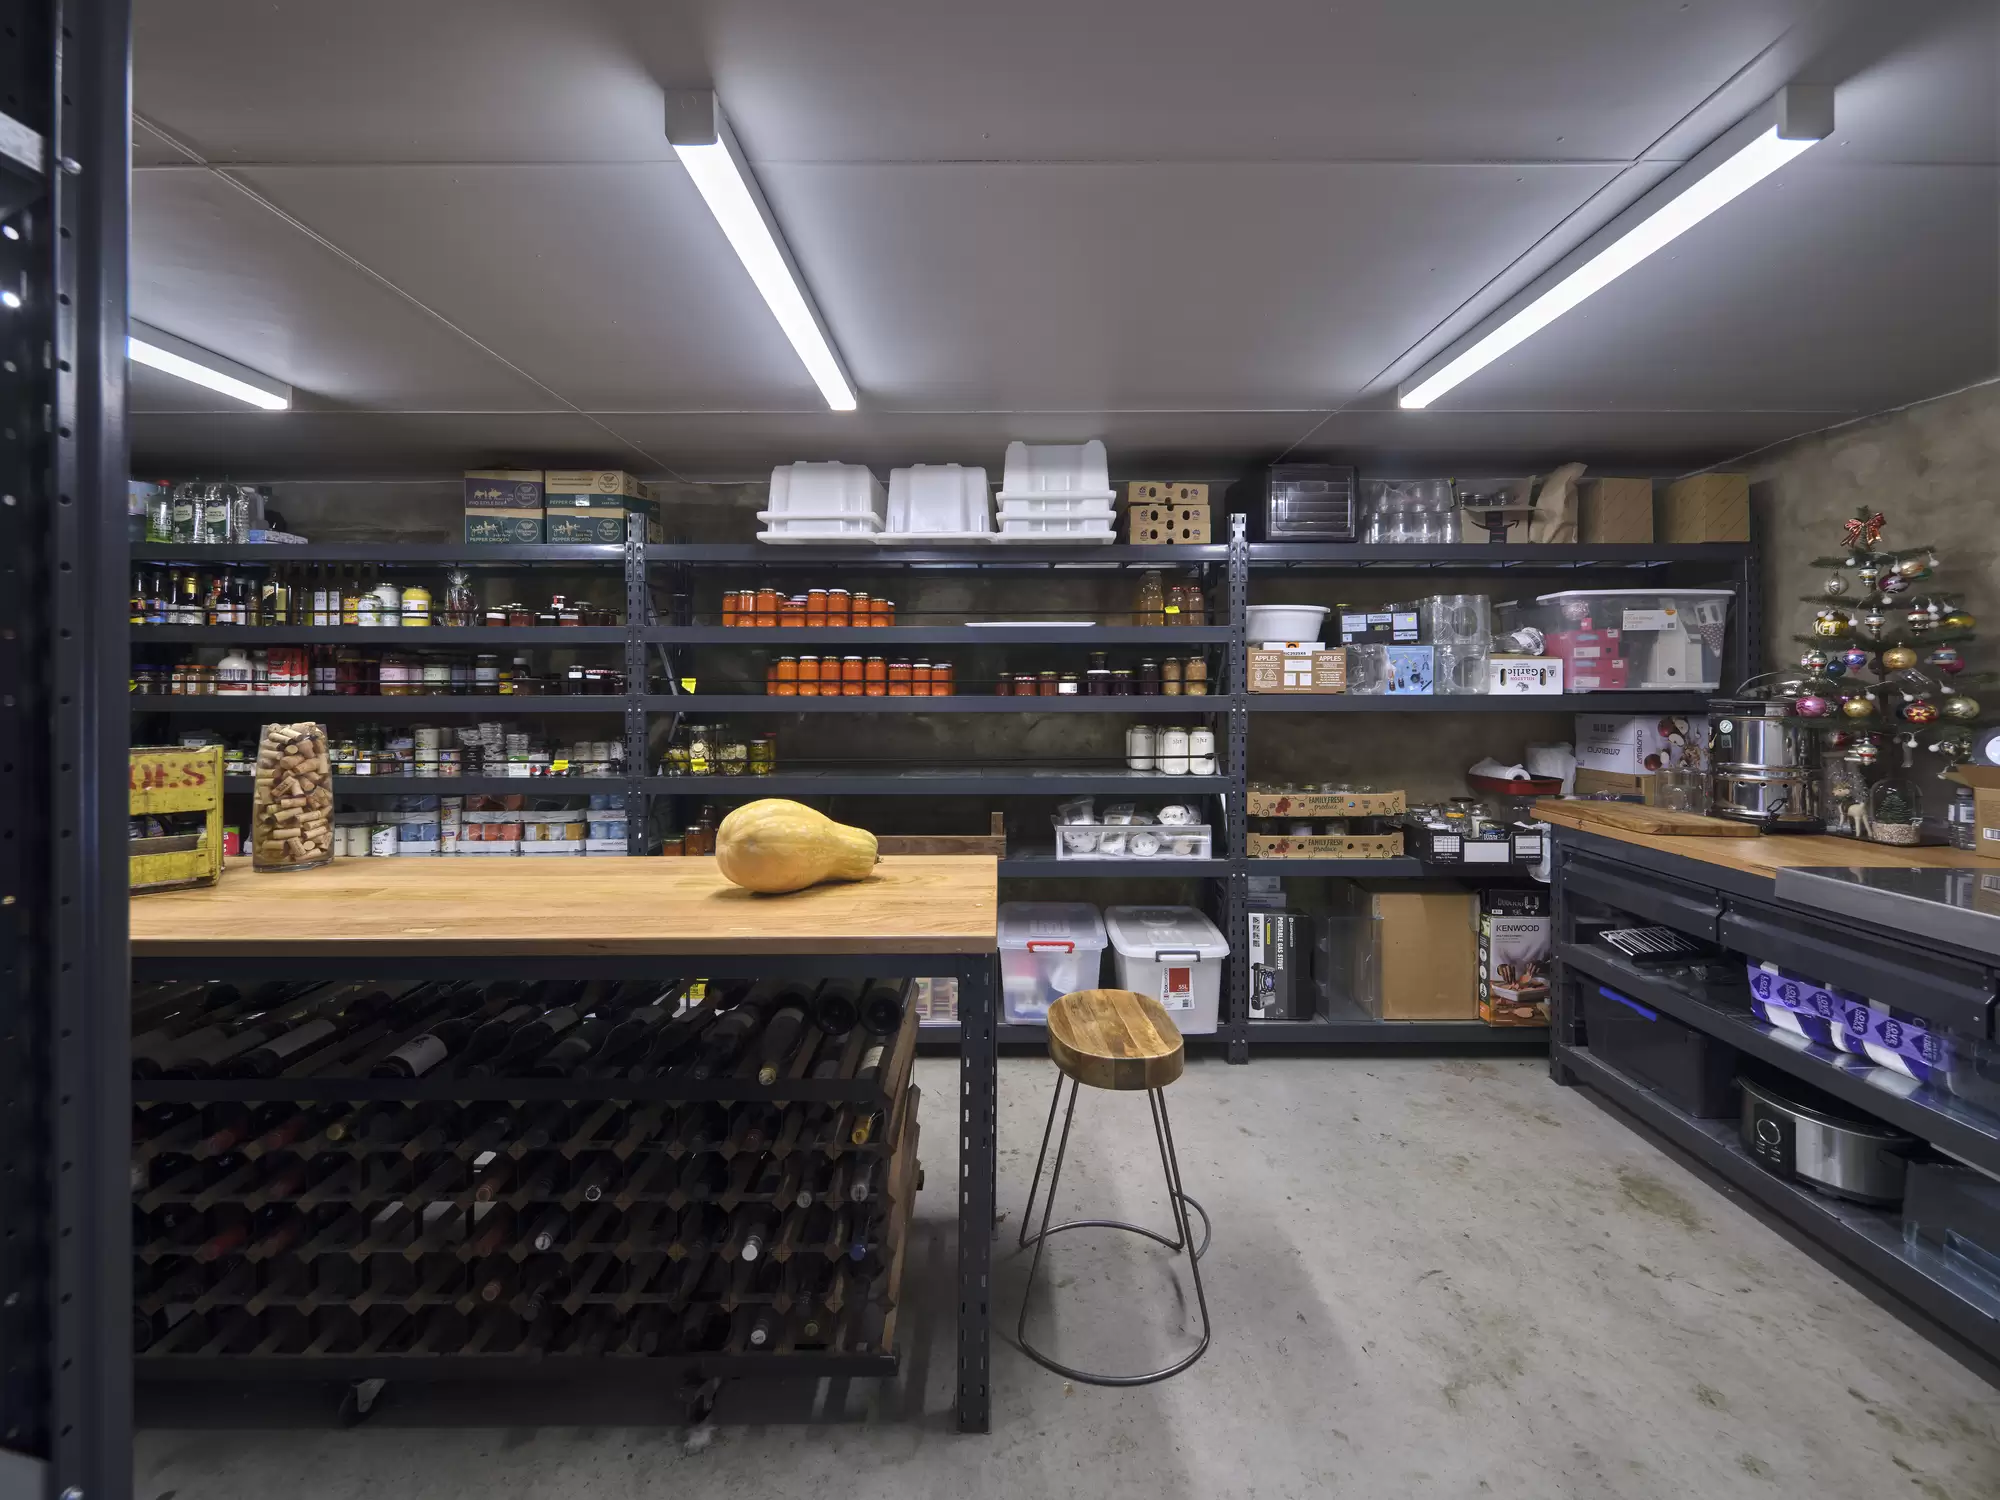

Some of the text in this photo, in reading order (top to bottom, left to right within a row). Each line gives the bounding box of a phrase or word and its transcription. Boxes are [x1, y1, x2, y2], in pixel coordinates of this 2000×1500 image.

[1507, 668, 1538, 677] Garlic
[1308, 796, 1344, 804] FAMILY FRESH
[1308, 838, 1327, 846] FAMILY
[1820, 993, 1831, 1017] LOVE
[1859, 1011, 1867, 1033] LOVE
[1890, 1021, 1900, 1047] LOVE
